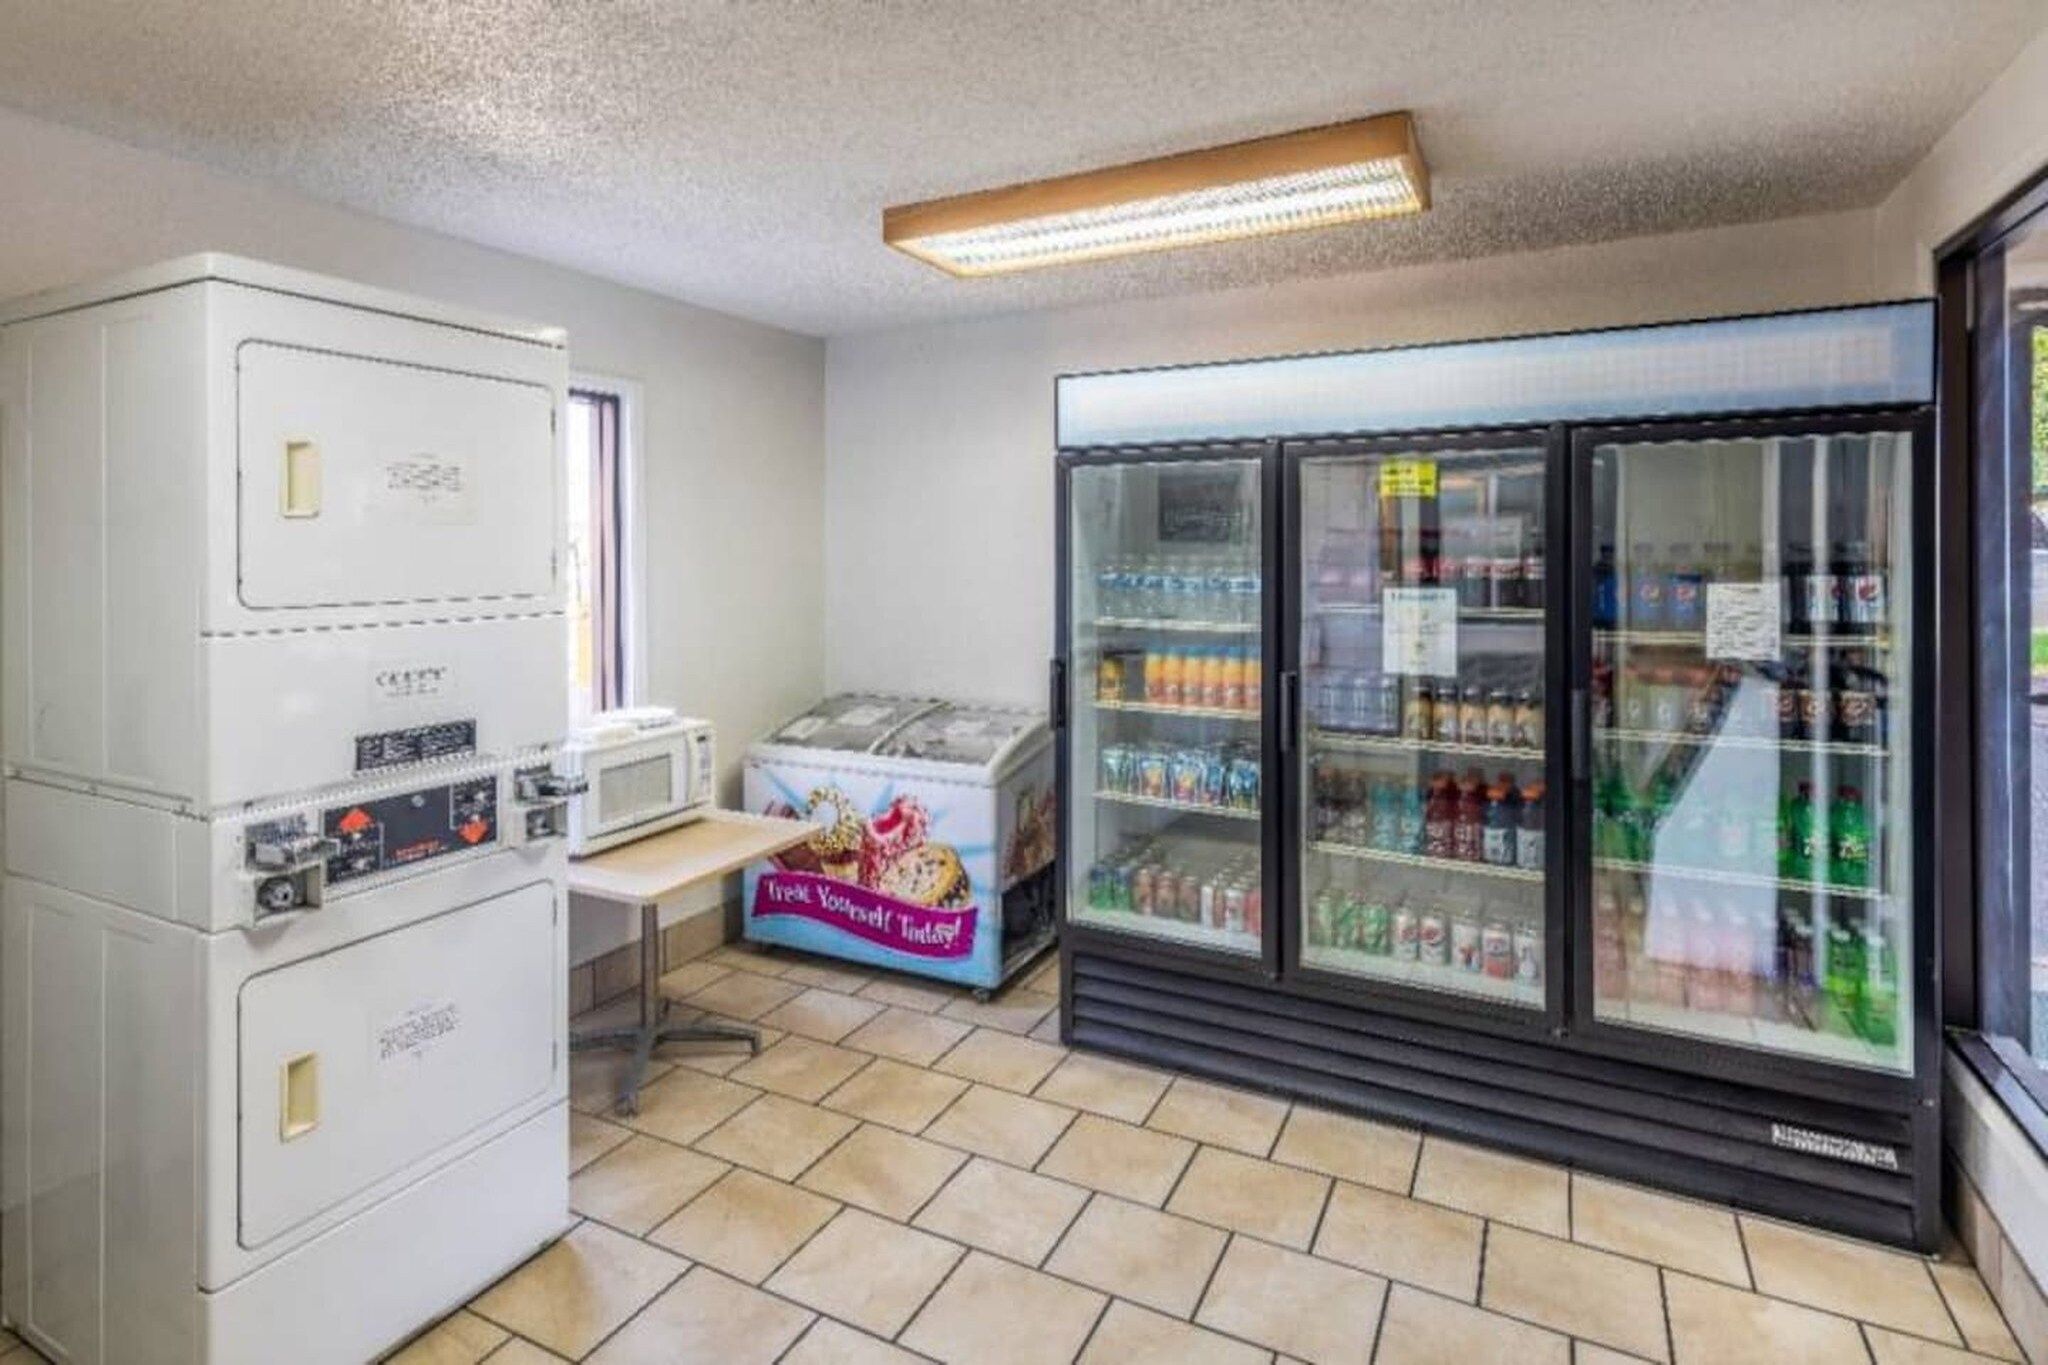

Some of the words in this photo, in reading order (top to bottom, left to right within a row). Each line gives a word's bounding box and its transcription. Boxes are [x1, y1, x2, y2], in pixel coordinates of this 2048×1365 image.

[765, 880, 810, 904] Treat
[817, 884, 891, 932] Yourself
[897, 913, 961, 949] Today!
